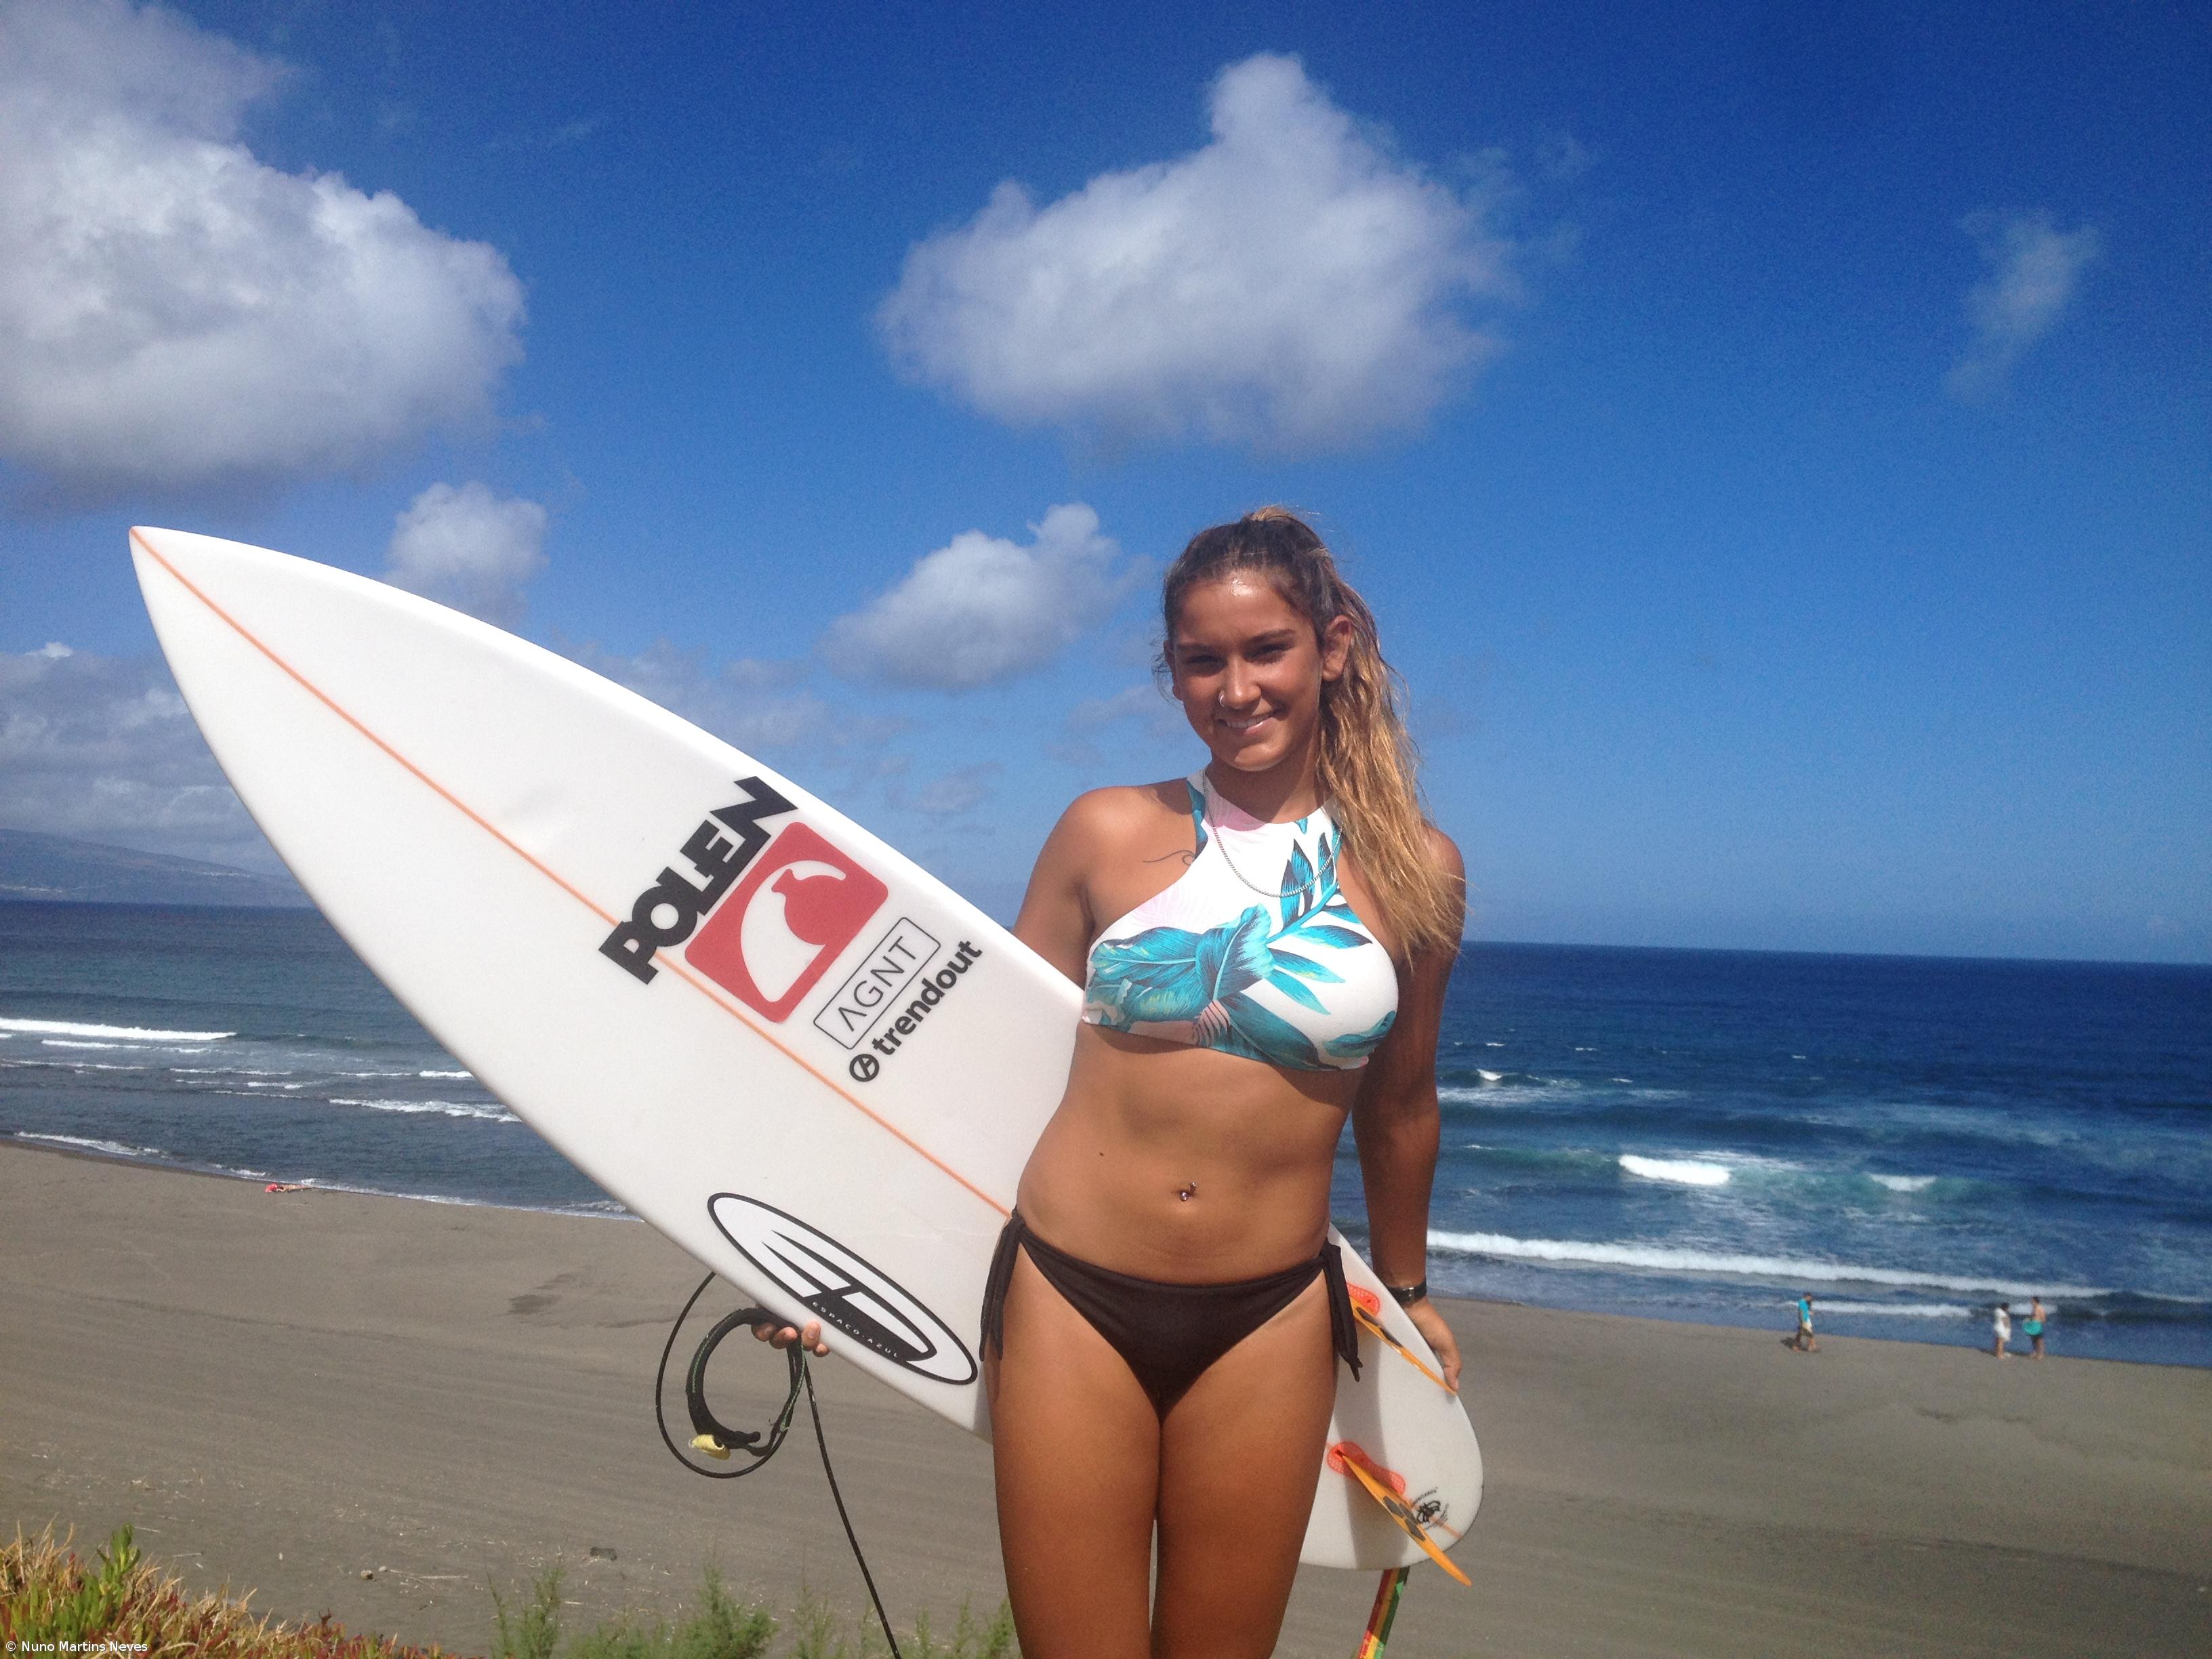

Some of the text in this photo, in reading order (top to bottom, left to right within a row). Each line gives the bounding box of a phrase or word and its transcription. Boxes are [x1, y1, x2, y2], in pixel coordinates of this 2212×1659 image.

[598, 775, 799, 985] POLEN
[837, 935, 917, 1032] AGNT
[871, 940, 983, 1055] trendout
